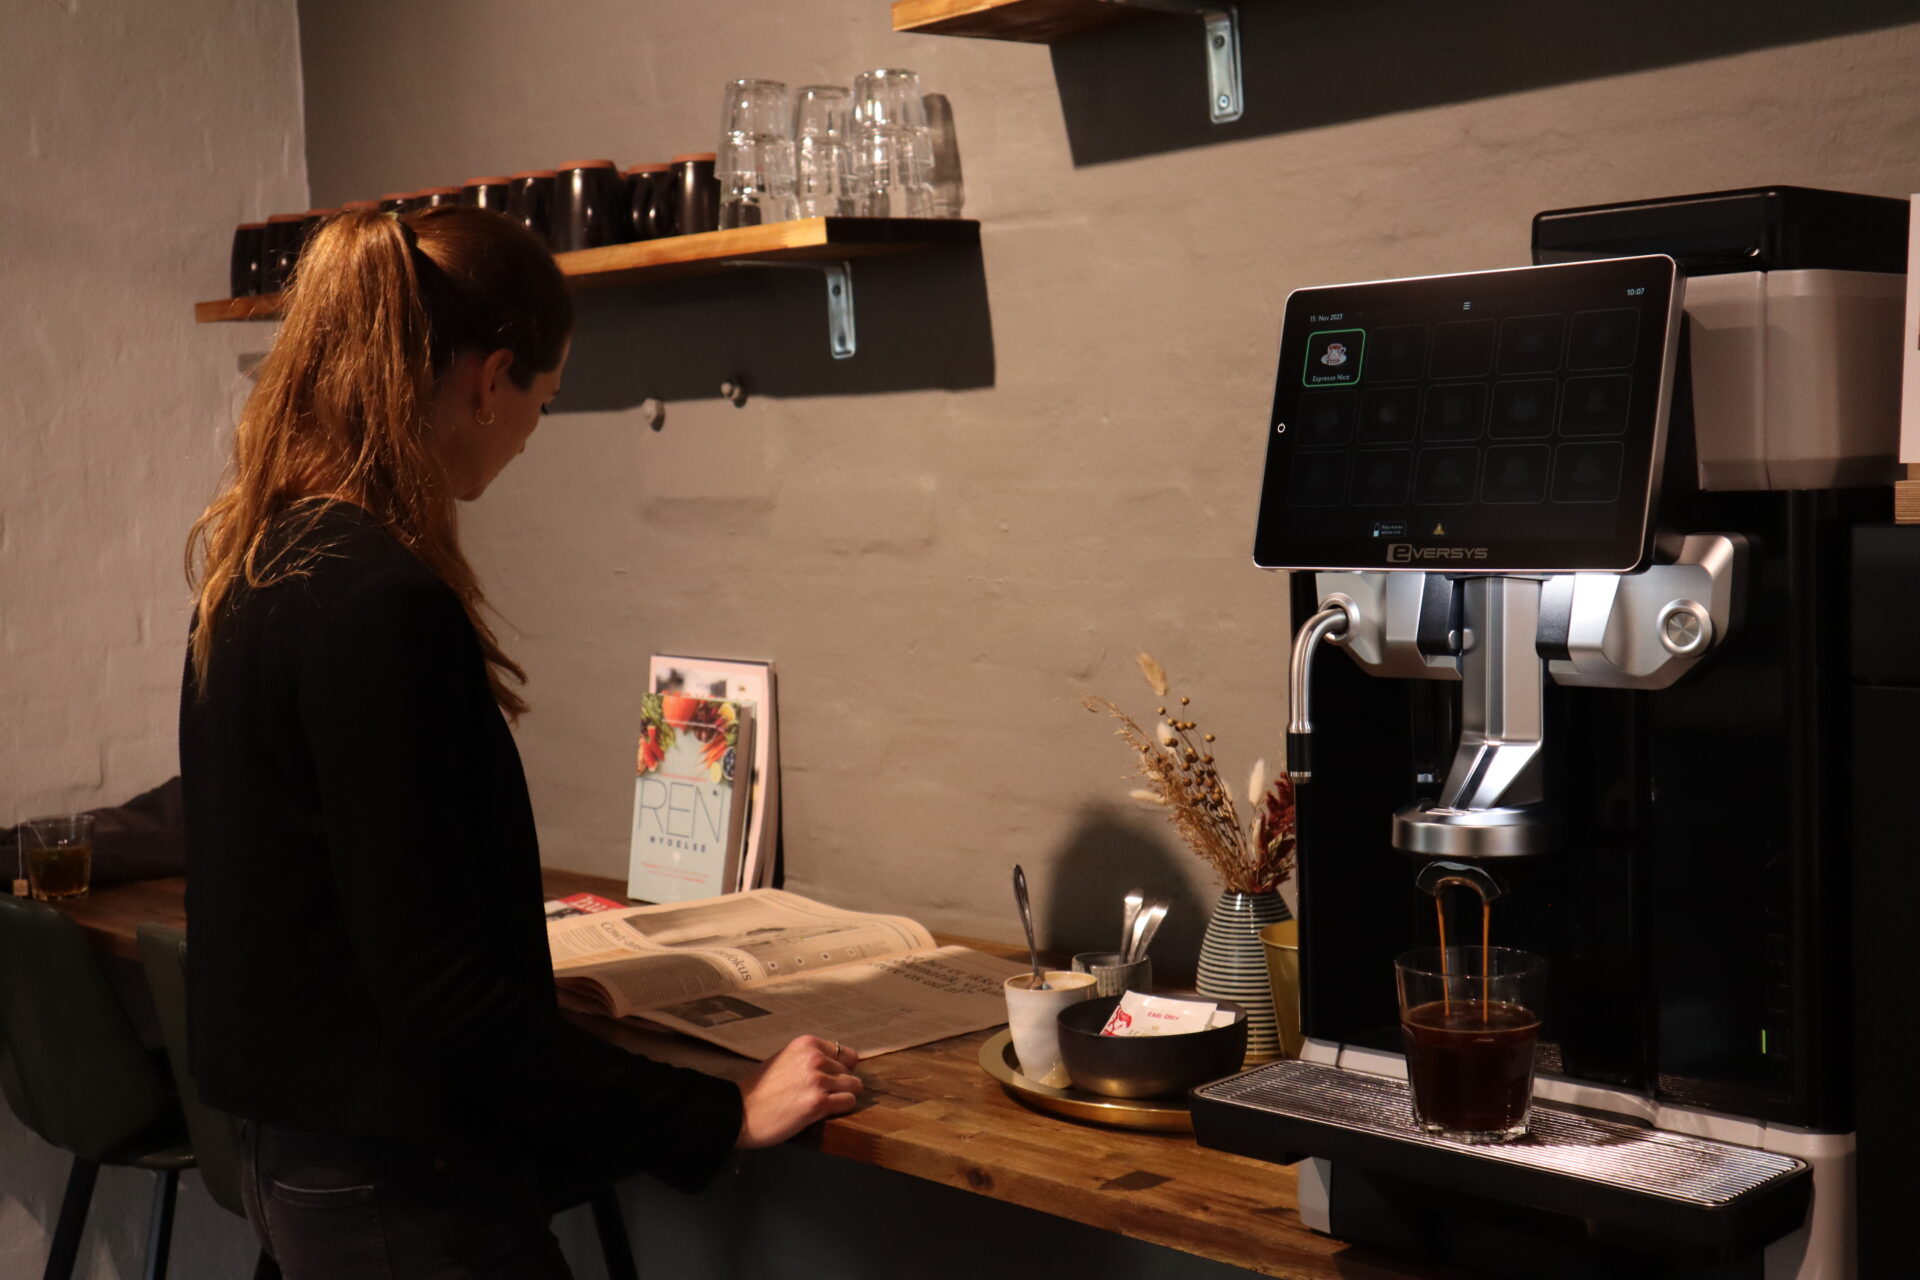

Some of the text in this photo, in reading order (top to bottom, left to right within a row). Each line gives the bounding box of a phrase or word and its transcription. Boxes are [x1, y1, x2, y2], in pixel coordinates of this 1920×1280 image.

[1627, 287, 1645, 296] 10:07
[1312, 375, 1336, 384] Espresso
[638, 777, 725, 843] REN
[649, 835, 707, 854] NYDELSE
[1147, 1011, 1163, 1020] EARL
